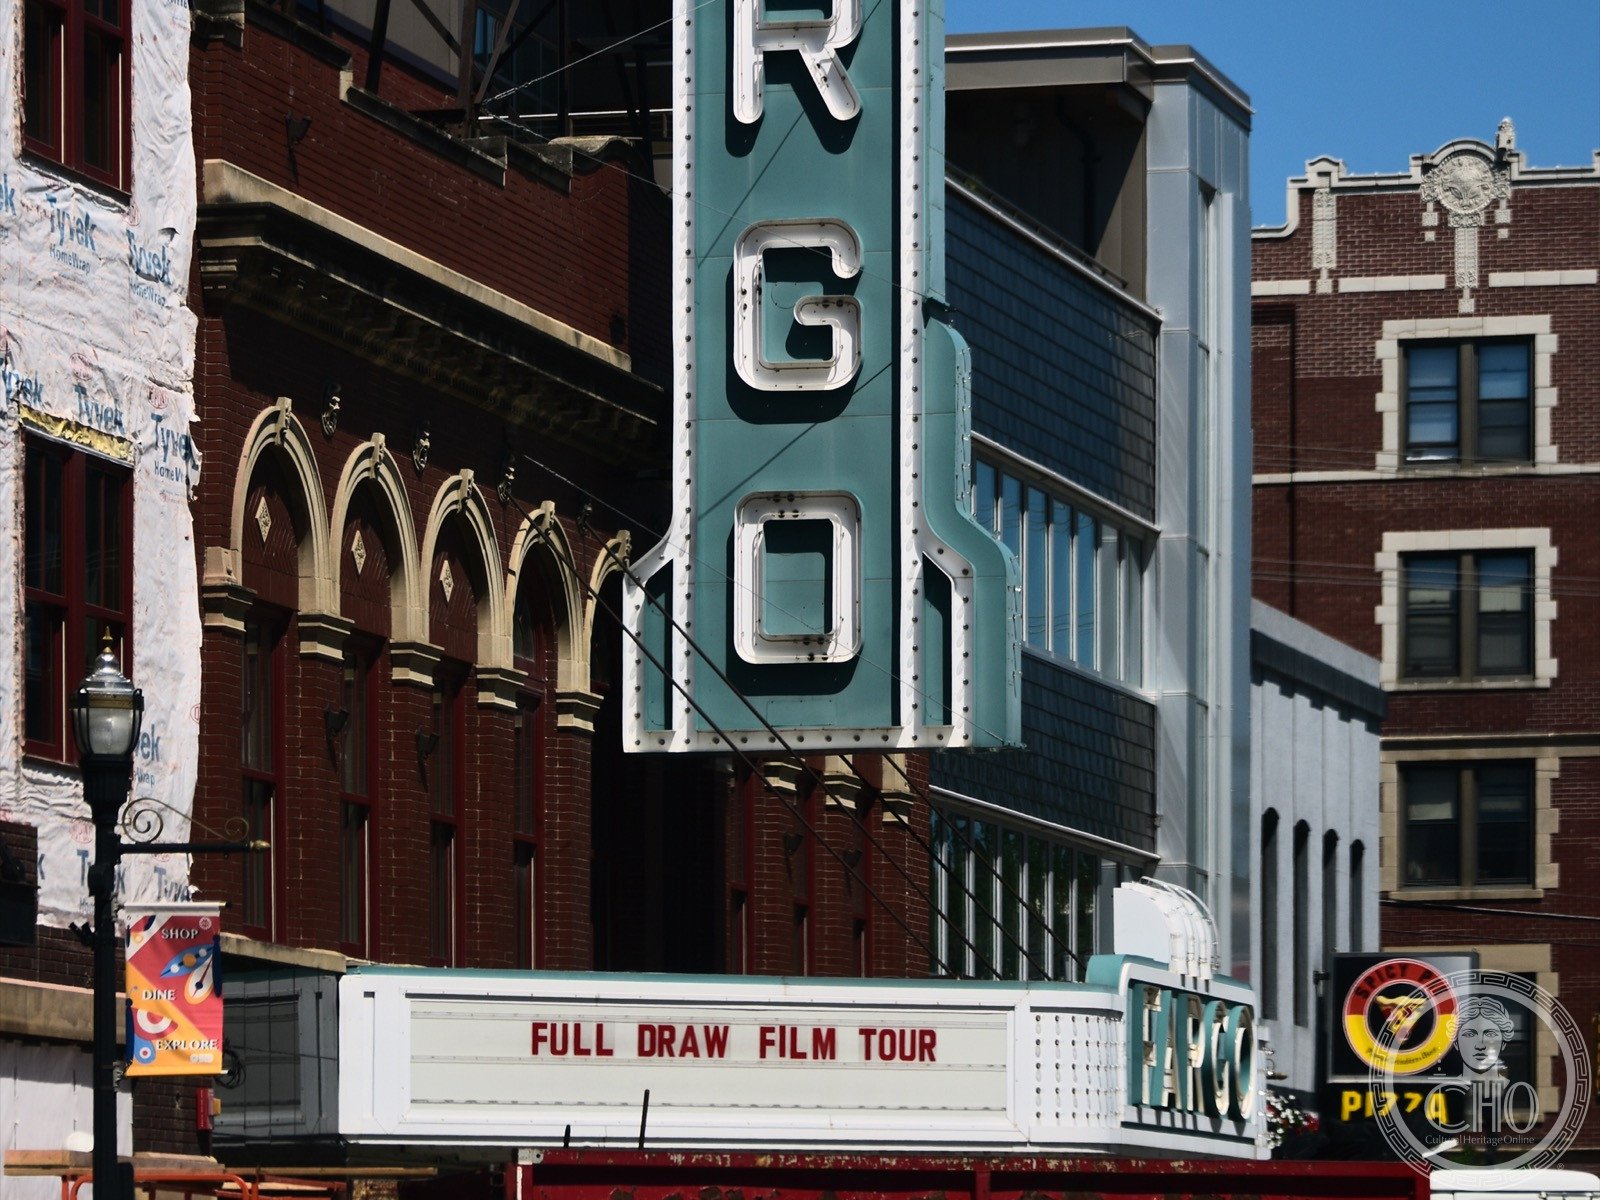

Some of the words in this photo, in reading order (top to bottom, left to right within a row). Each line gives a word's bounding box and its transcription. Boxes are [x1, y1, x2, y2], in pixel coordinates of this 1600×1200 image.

[45, 192, 97, 252] Tyvek
[49, 243, 91, 276] HomeWrap
[126, 229, 173, 287] Tyvek
[74, 382, 125, 434] Tyvek
[161, 928, 199, 939] SHOP
[143, 989, 177, 1000] DINE
[1355, 964, 1408, 998] SPICY
[156, 1039, 219, 1051] EXPLORE
[531, 1022, 614, 1056] FULL
[638, 1024, 729, 1059] DRAW
[759, 1025, 837, 1060] FILM
[859, 1028, 937, 1062] TOUR
[1133, 984, 1258, 1120] FARGO
